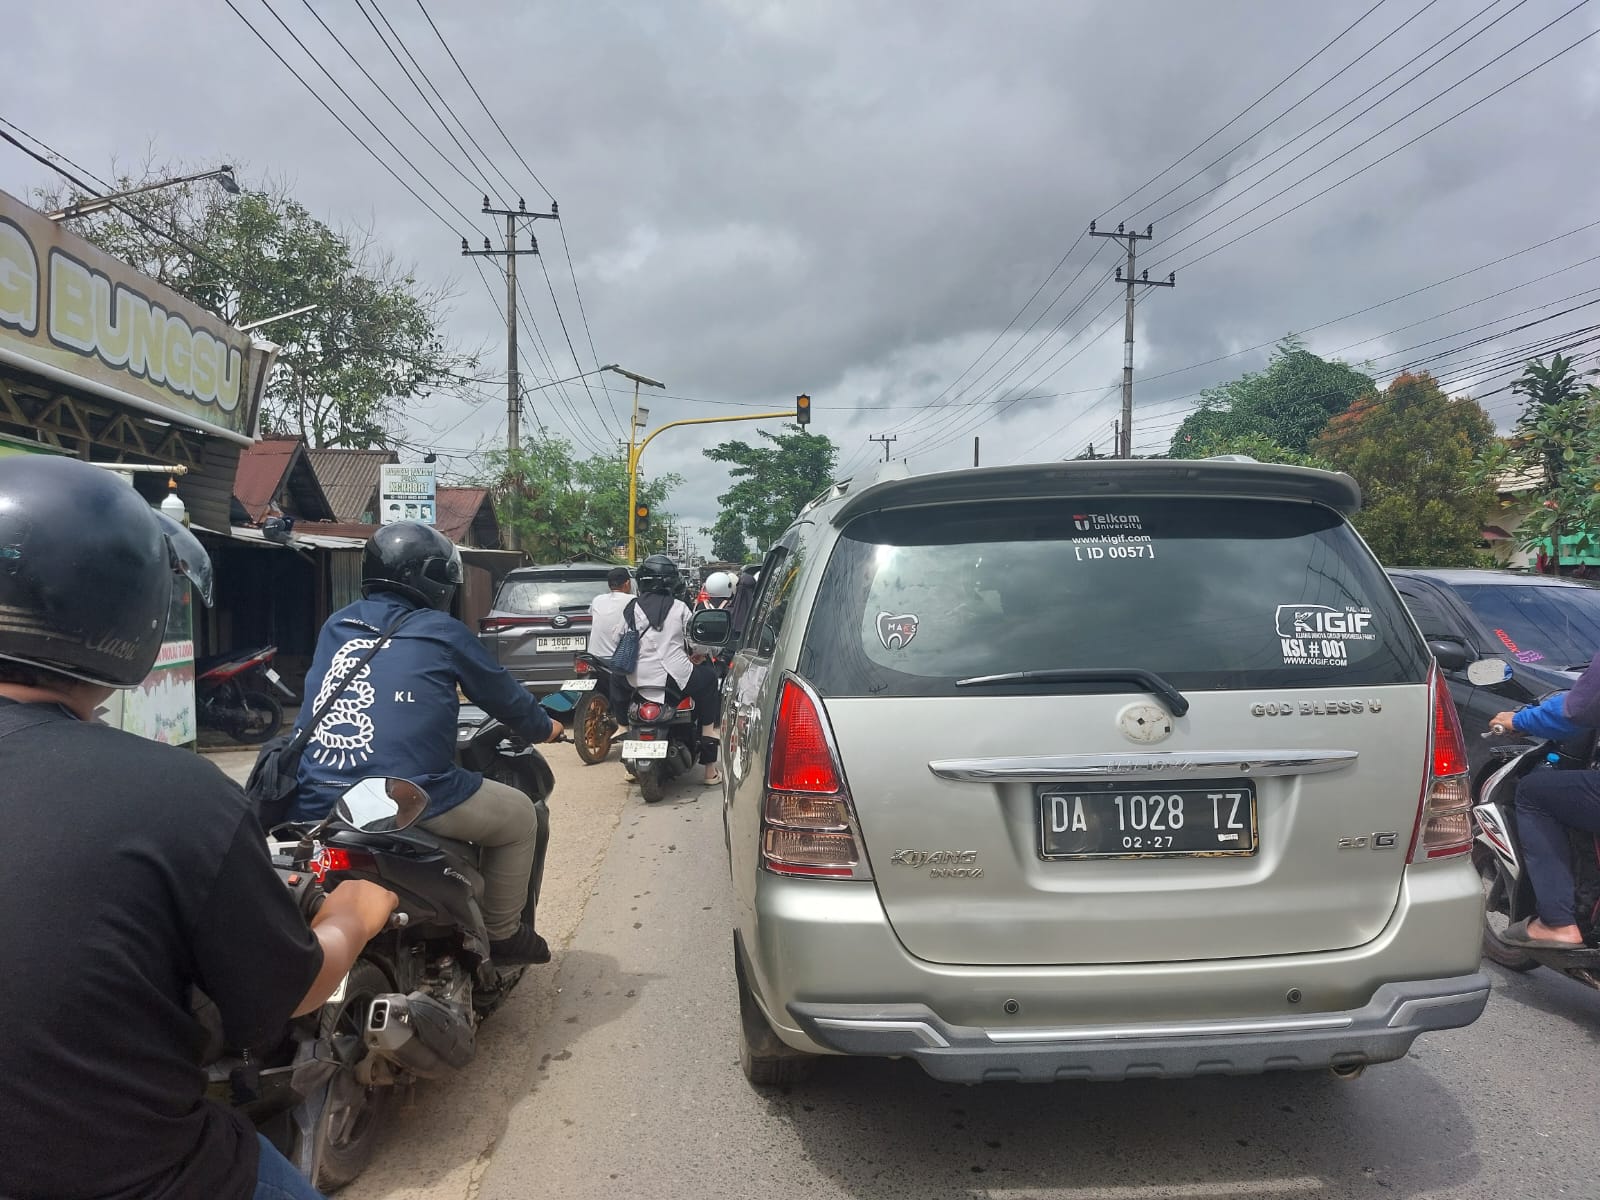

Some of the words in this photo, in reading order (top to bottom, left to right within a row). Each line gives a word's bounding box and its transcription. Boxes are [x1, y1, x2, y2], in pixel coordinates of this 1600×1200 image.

[47, 246, 242, 414] BUNGSU
[1089, 513, 1140, 523] Telkom
[1072, 534, 1151, 544] www.kigif.com
[1293, 611, 1372, 633] KIGIF
[538, 638, 548, 646] DA
[1283, 657, 1347, 666] WWW.KIGIF.COM
[1251, 702, 1293, 718] GOD
[1298, 700, 1364, 716] BLESS
[1368, 698, 1382, 714] U
[1051, 797, 1087, 832] DA
[1114, 795, 1184, 831] 1028
[1207, 793, 1244, 829] TZ
[1371, 831, 1398, 849] G
